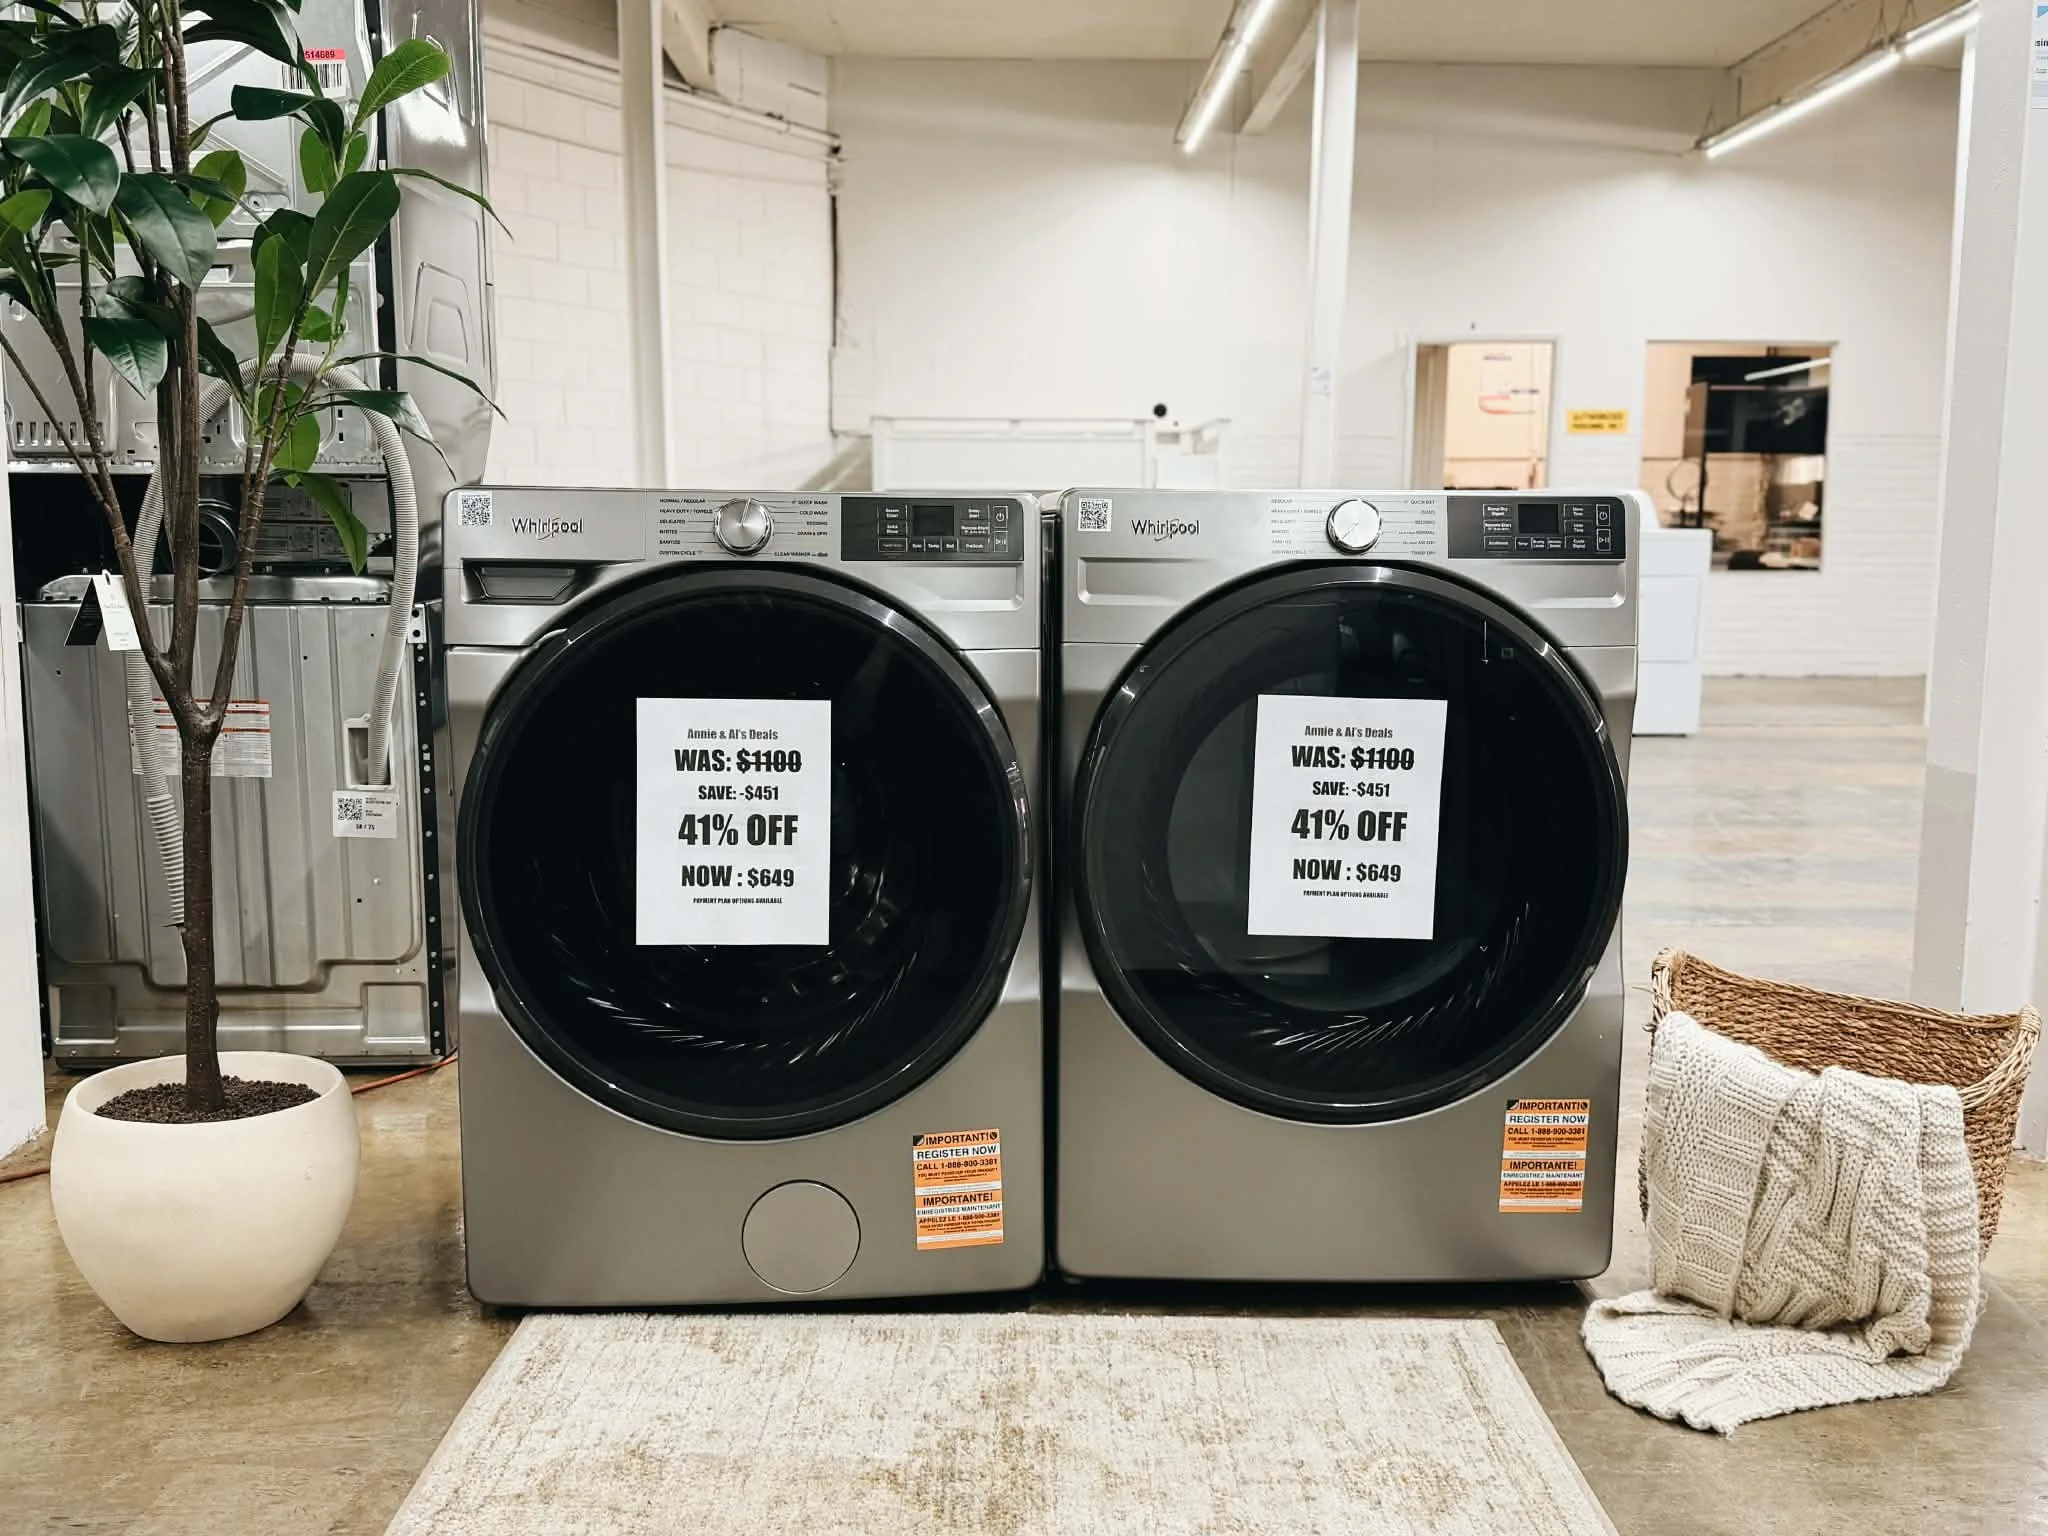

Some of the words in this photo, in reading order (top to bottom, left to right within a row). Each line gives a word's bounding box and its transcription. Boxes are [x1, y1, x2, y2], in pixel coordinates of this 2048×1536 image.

[511, 517, 584, 540] Whirlpool
[1130, 519, 1200, 541] Whirlpool
[687, 728, 718, 740] Annie
[719, 730, 727, 740] &
[728, 728, 747, 740] Al's
[749, 728, 778, 741] Deals
[1304, 725, 1334, 738] Annie
[1336, 726, 1342, 738] &
[1344, 726, 1362, 738] Al's
[1364, 726, 1393, 739] Deals
[674, 748, 732, 772] WAS:
[736, 748, 802, 774] $1100
[1291, 744, 1346, 768] WAS:
[1350, 746, 1415, 771] $1100
[698, 785, 737, 800] SAVE:
[739, 784, 779, 801] -$451
[1312, 780, 1349, 796] SAVE:
[1351, 782, 1390, 798] -$451
[678, 814, 738, 846] 41%
[746, 814, 798, 846] OFF
[1291, 809, 1350, 841] 41%
[1357, 810, 1408, 842] OFF
[681, 865, 732, 887] NOW
[747, 868, 794, 888] $649
[1293, 858, 1342, 881] NOW
[1356, 862, 1401, 883] $649
[1519, 1101, 1580, 1110] IMPORTANT!
[1509, 1115, 1560, 1124] REGISTER
[1562, 1115, 1586, 1124] NOW
[925, 1132, 989, 1146] IMPORTANT!
[1508, 1127, 1528, 1135] CALL
[917, 1147, 969, 1160] REGISTER
[972, 1145, 997, 1156] NOW
[916, 1162, 938, 1171] CALL
[1510, 1161, 1577, 1170] IMPORTANTE!
[923, 1192, 993, 1207] IMPORTANTE!
